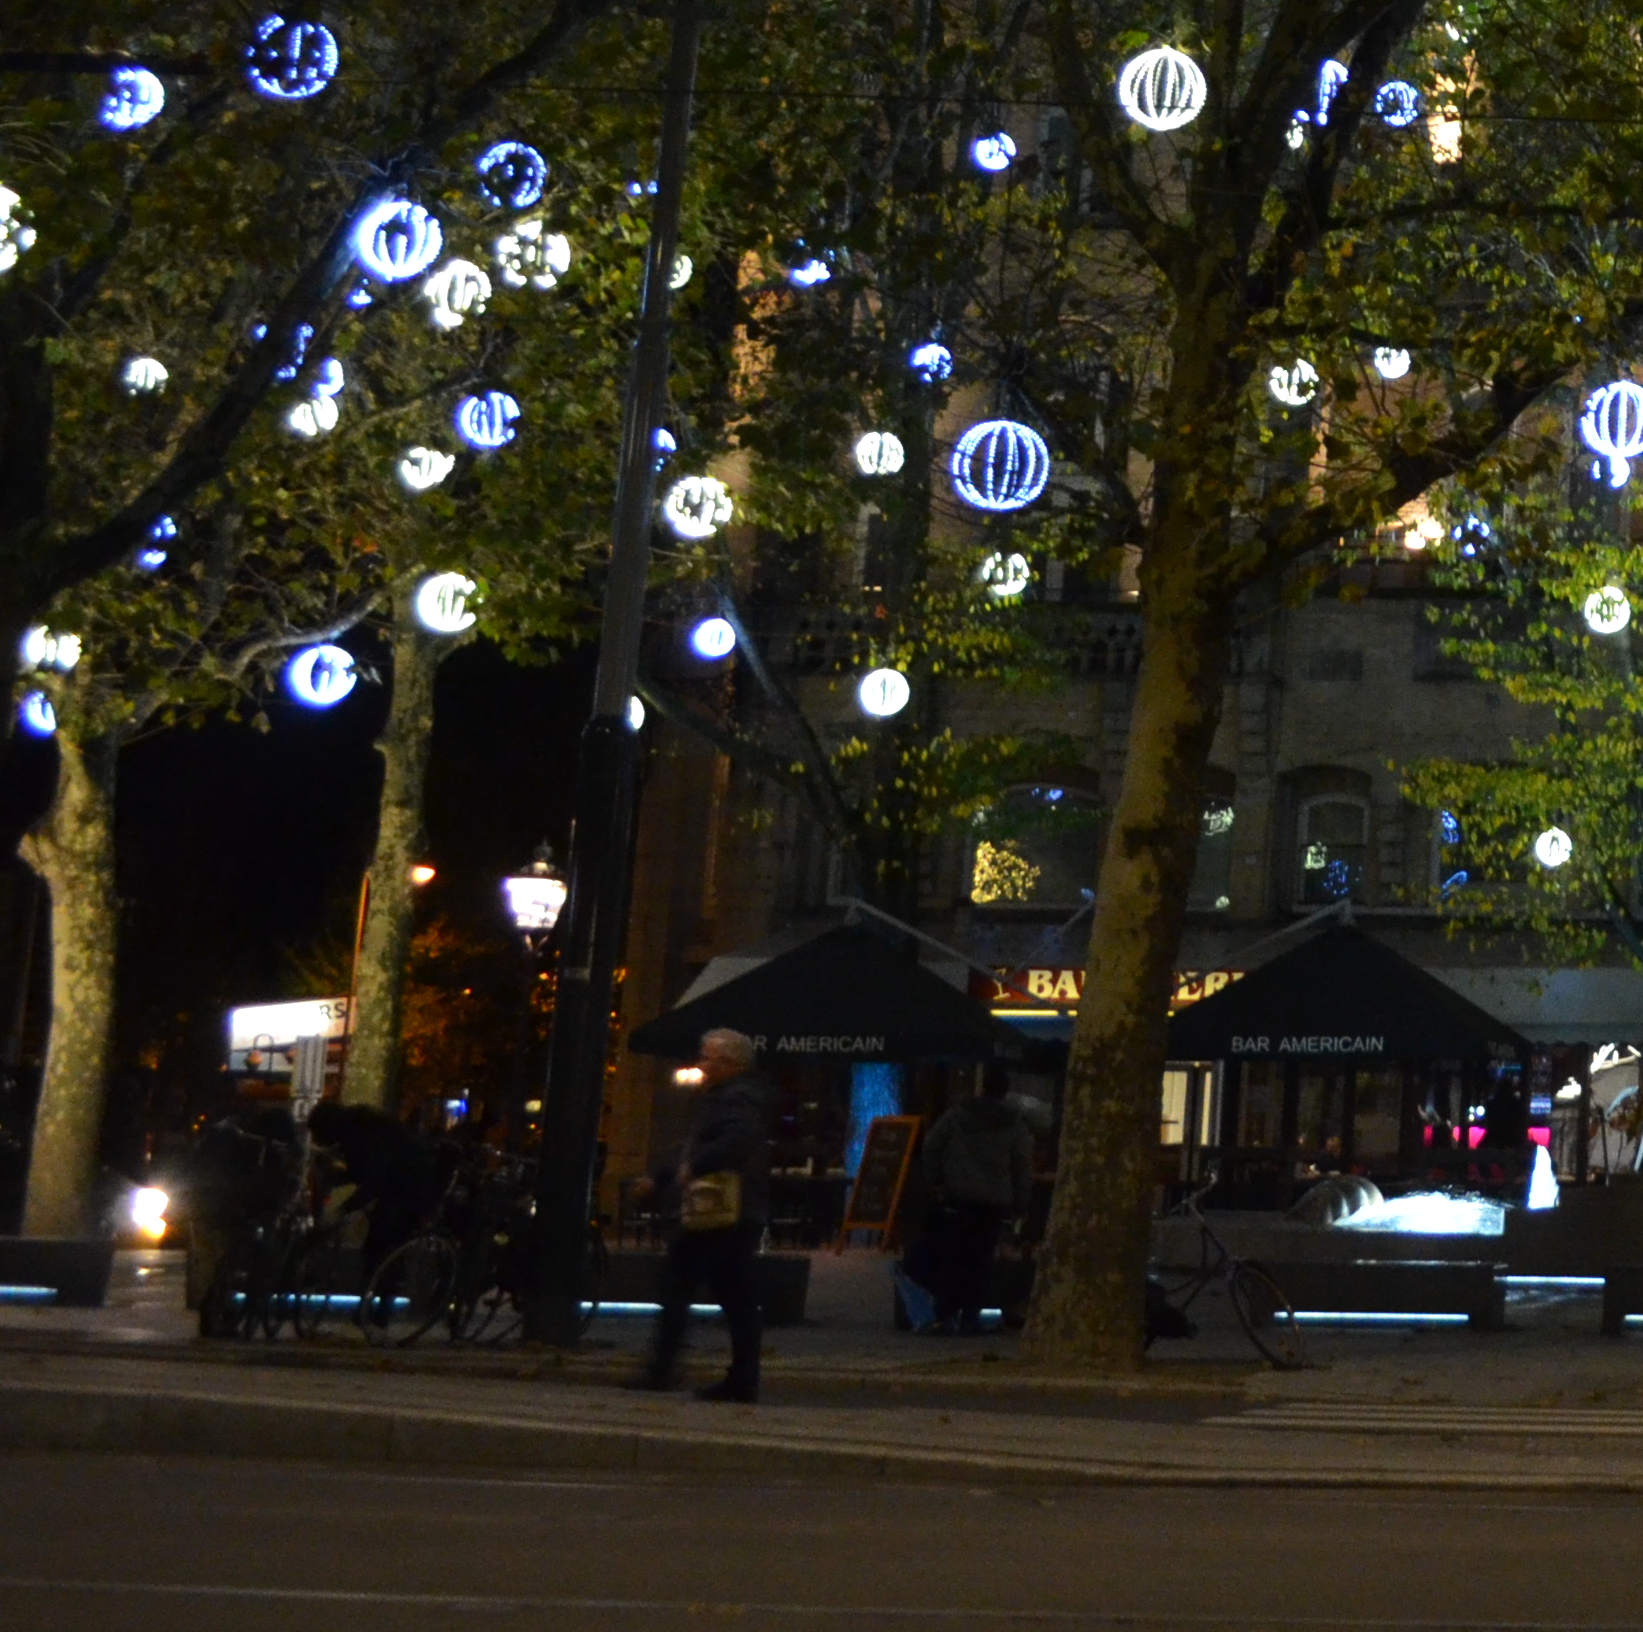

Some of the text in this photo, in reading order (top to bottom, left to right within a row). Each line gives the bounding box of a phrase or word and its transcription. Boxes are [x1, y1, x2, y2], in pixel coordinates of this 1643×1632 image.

[776, 1034, 885, 1053] AMERICAIN
[1231, 1035, 1384, 1053] BAR AMERICAIN
